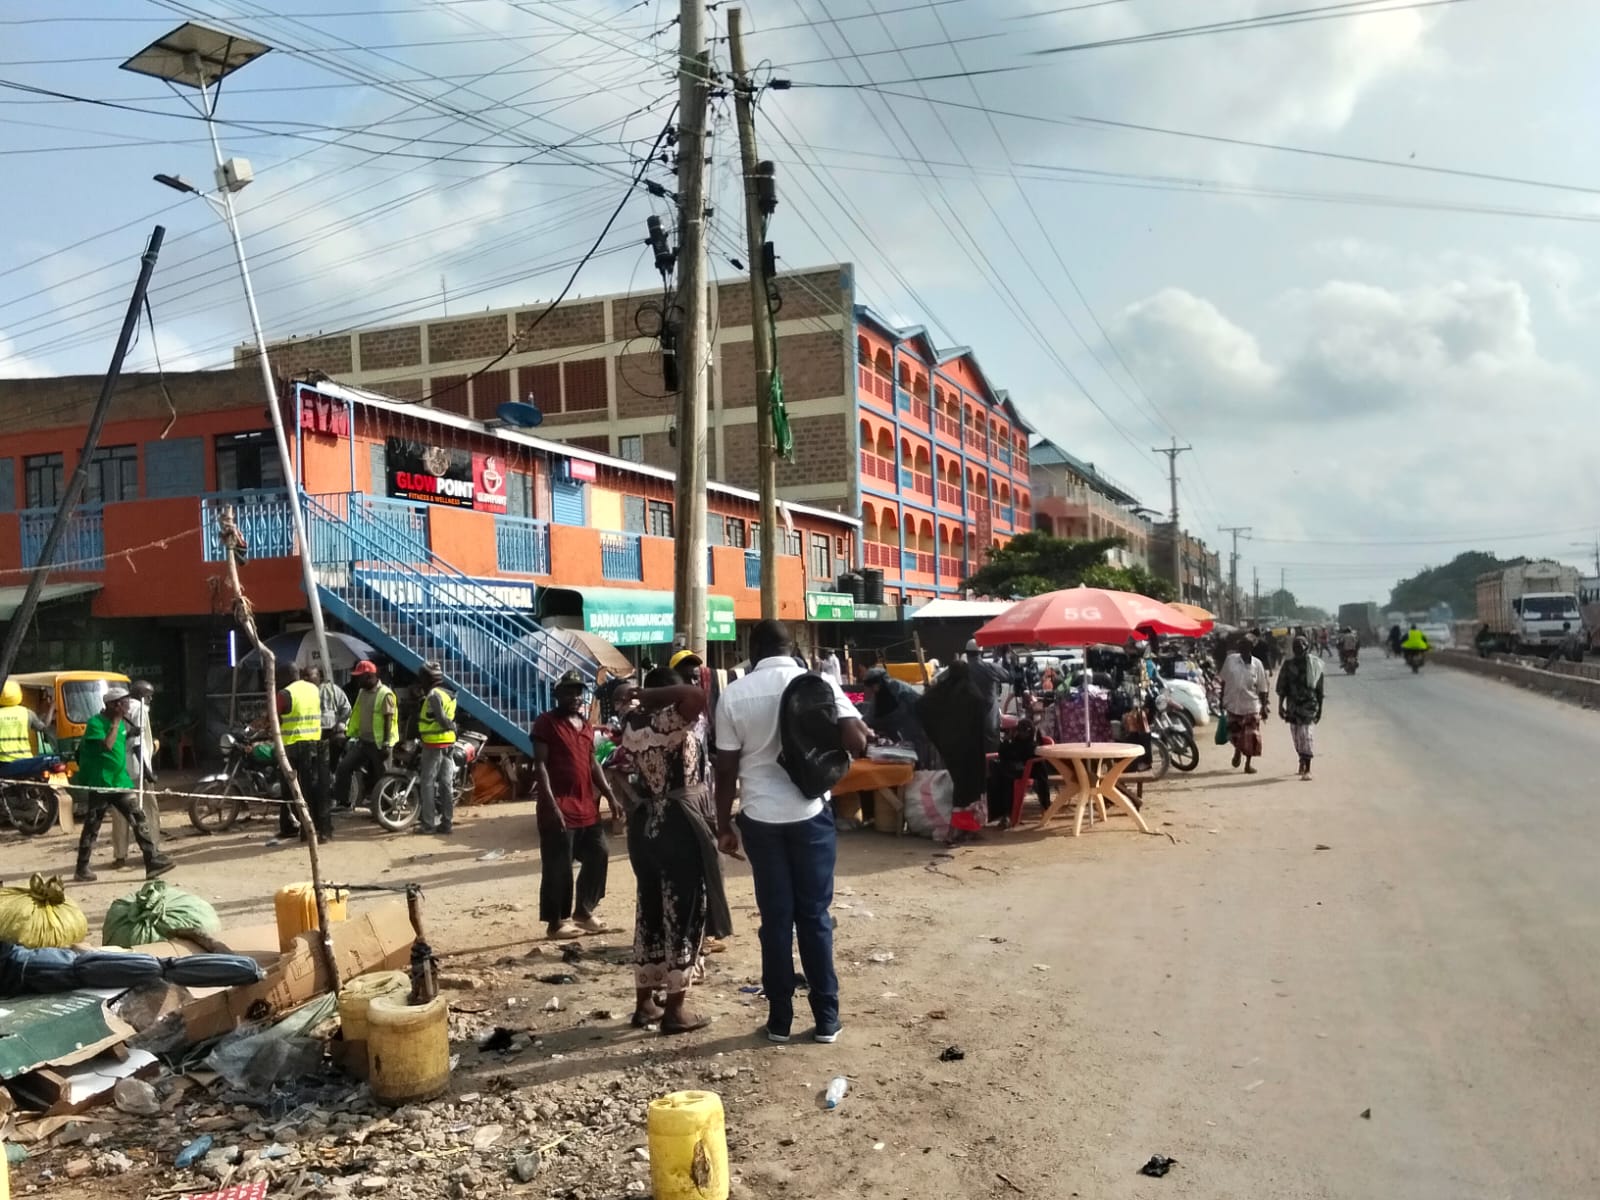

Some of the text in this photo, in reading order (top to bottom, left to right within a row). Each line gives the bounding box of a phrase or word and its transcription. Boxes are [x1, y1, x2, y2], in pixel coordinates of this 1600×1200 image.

[300, 398, 350, 436] GYM
[396, 472, 474, 498] GLOWPOINT
[408, 492, 429, 501] FITNESS
[434, 496, 460, 505] WELLNESS
[590, 613, 625, 627] BARAKA
[1064, 607, 1101, 620] 5G
